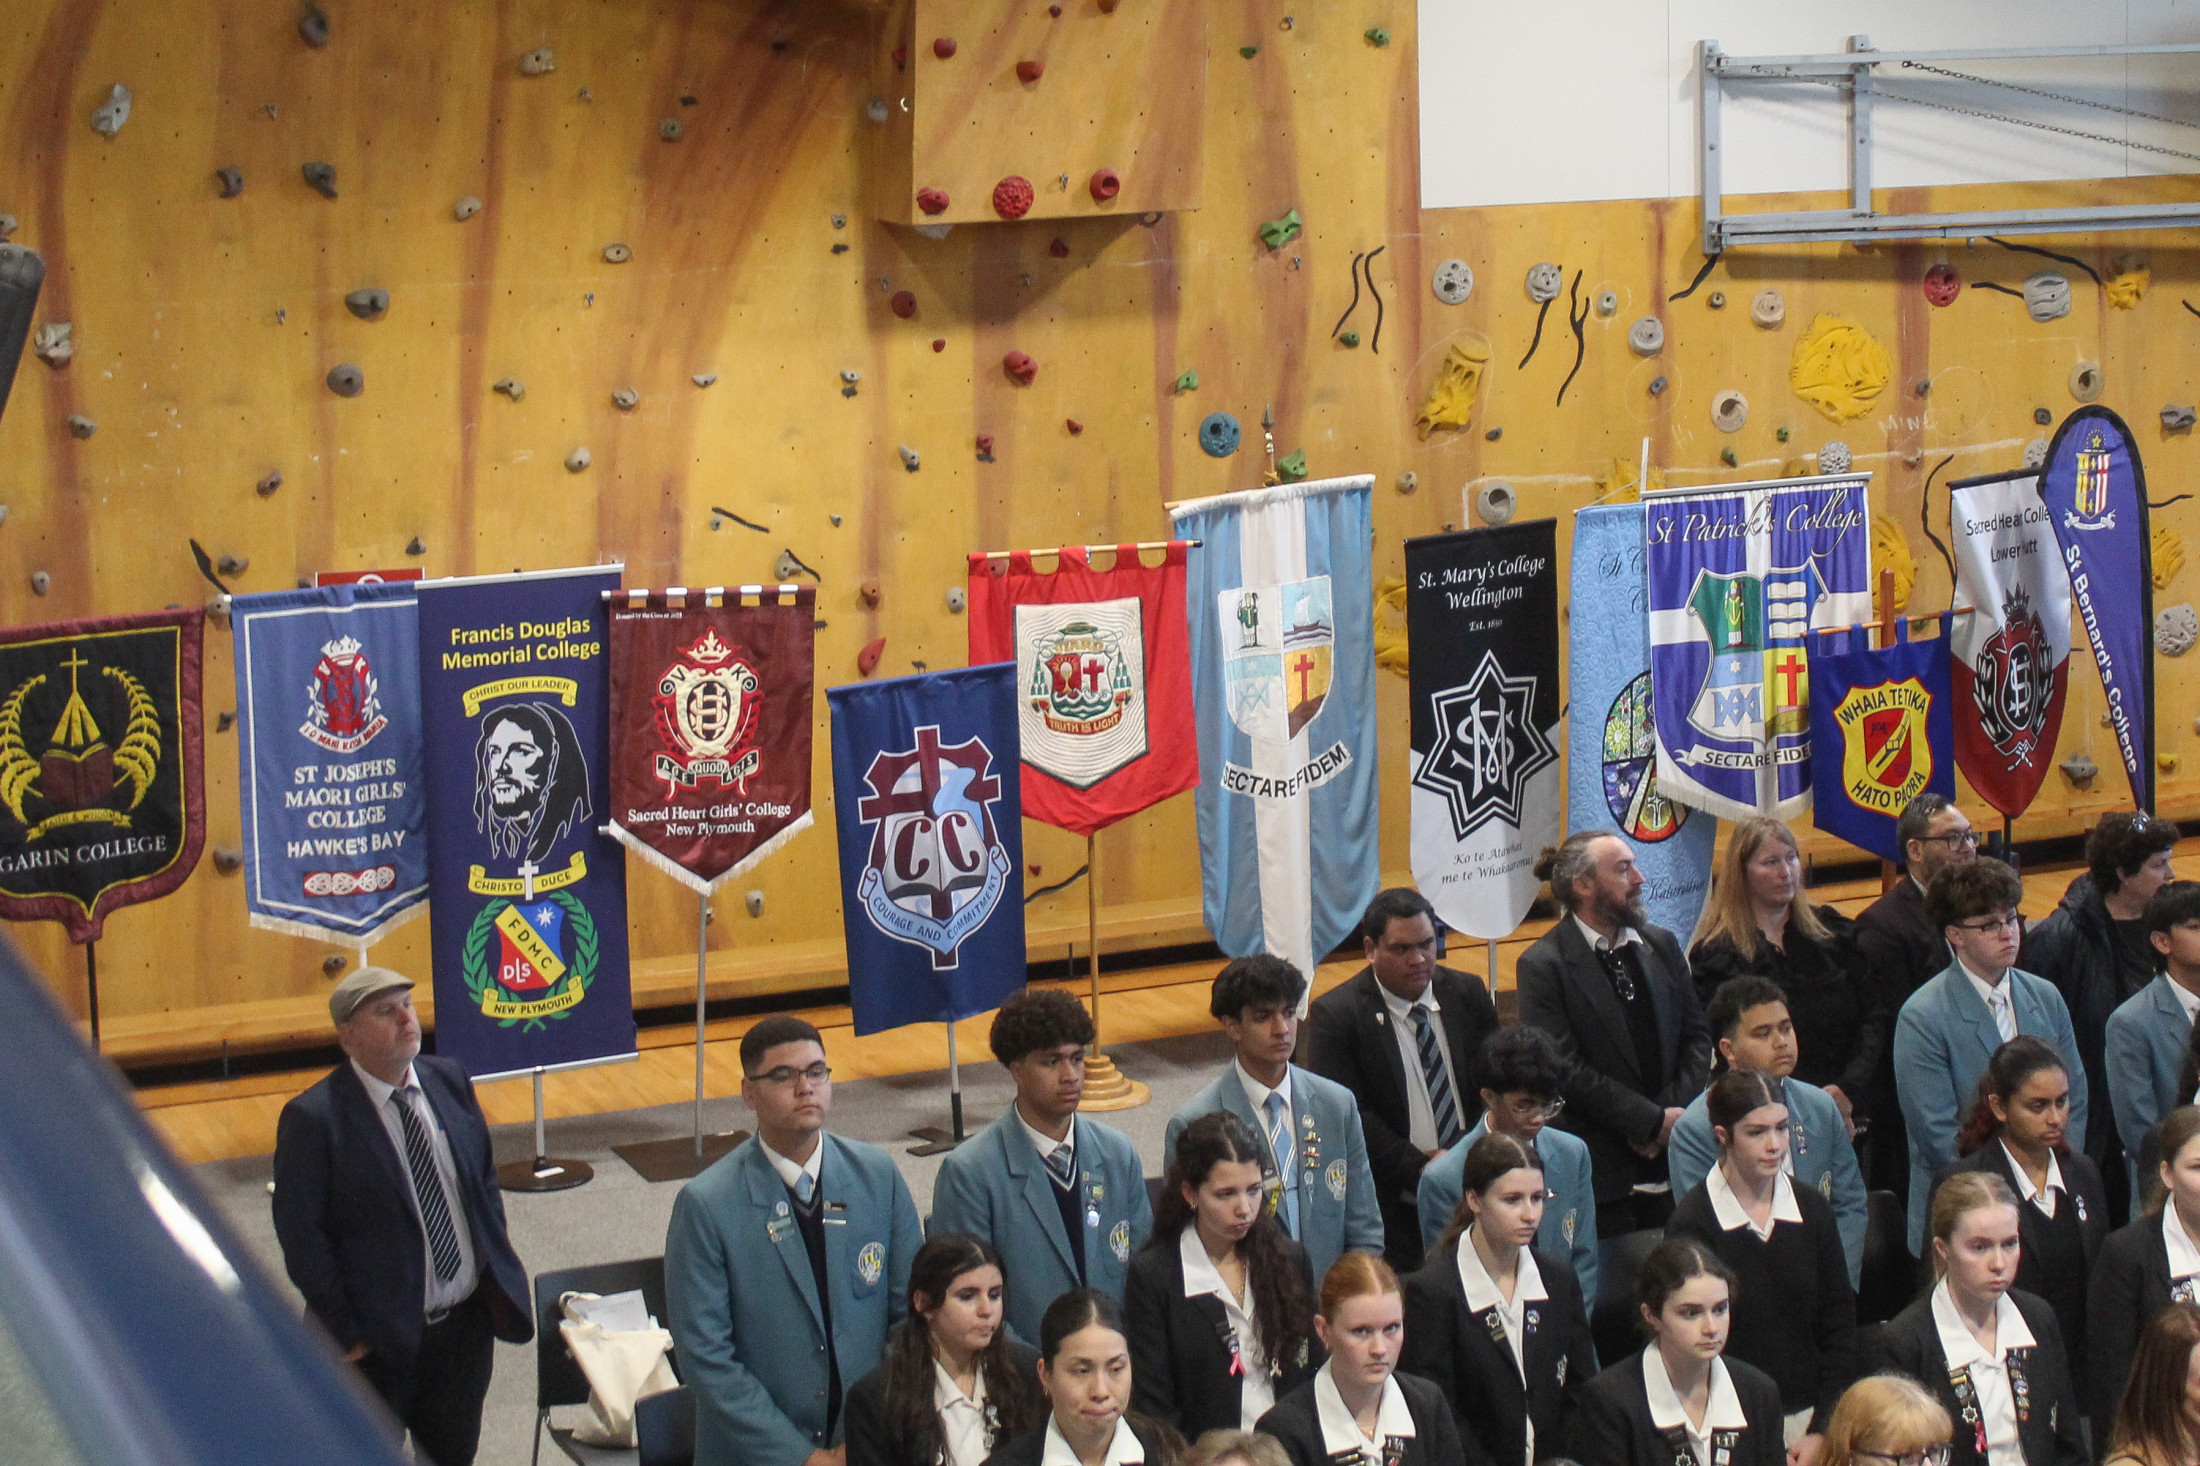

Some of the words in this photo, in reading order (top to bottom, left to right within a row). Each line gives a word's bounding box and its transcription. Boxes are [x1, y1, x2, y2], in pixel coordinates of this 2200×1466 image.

[1648, 516, 1676, 545] St
[1682, 496, 1776, 542] Patrick's
[1786, 488, 1864, 558] College
[1966, 514, 1997, 536] Sacred
[2024, 506, 2050, 524] Colle
[1991, 545, 2021, 562] Lower
[2021, 538, 2038, 554] utt
[2066, 543, 2083, 573] St
[1418, 571, 1437, 589] St.
[1441, 561, 1495, 586] Mary's
[1497, 554, 1545, 578] College
[1445, 585, 1523, 609] Wellington
[451, 623, 514, 646] Francis
[519, 616, 591, 640] Douglas
[1469, 621, 1485, 632] Est.
[2073, 572, 2113, 684] Bernard's
[442, 644, 531, 670] Memorial
[536, 640, 600, 661] College
[469, 683, 504, 700] CHRIST
[507, 681, 529, 692] OUR
[531, 679, 570, 691] LEADER
[1839, 691, 1888, 725] WHAIA
[1050, 719, 1078, 732] TRUTH
[1081, 722, 1091, 732] IS
[1093, 713, 1119, 730] LIGHT
[2107, 686, 2138, 774] College
[662, 759, 688, 783] AGE
[695, 761, 724, 774] QUOD
[726, 754, 753, 781] AGIS
[1703, 751, 1771, 768] SECTARE
[1774, 743, 1811, 764] FIDE
[294, 765, 319, 784] ST
[324, 758, 396, 783] JOSEPH'S
[1223, 765, 1296, 798] SECTARE
[1296, 744, 1347, 789] FIDEM
[285, 787, 351, 808] MAORI
[355, 781, 407, 803] GIRLS'
[1851, 779, 1891, 807] HATO
[1894, 771, 1926, 807] PAORA
[307, 805, 386, 828] COLLEGE
[627, 806, 669, 823] Sacred
[672, 806, 706, 820] Heart
[709, 803, 743, 818] Girls'
[745, 802, 792, 819] College
[666, 824, 695, 837] New
[697, 820, 755, 837] Plymouth
[0, 847, 69, 873] GARIN
[76, 834, 167, 863] COLLEGE
[287, 836, 368, 858] HAWKE'S
[371, 829, 406, 851] BAY
[1453, 852, 1470, 865] Ko
[474, 879, 523, 892] CHRISTO
[541, 870, 572, 887] DUCE
[1441, 873, 1458, 885] me
[873, 897, 914, 931] COURAGE
[917, 926, 941, 941] AND
[947, 875, 998, 940] COMMITMENT
[494, 1003, 517, 1014] NEW
[521, 994, 573, 1015] PLYMOUTH
